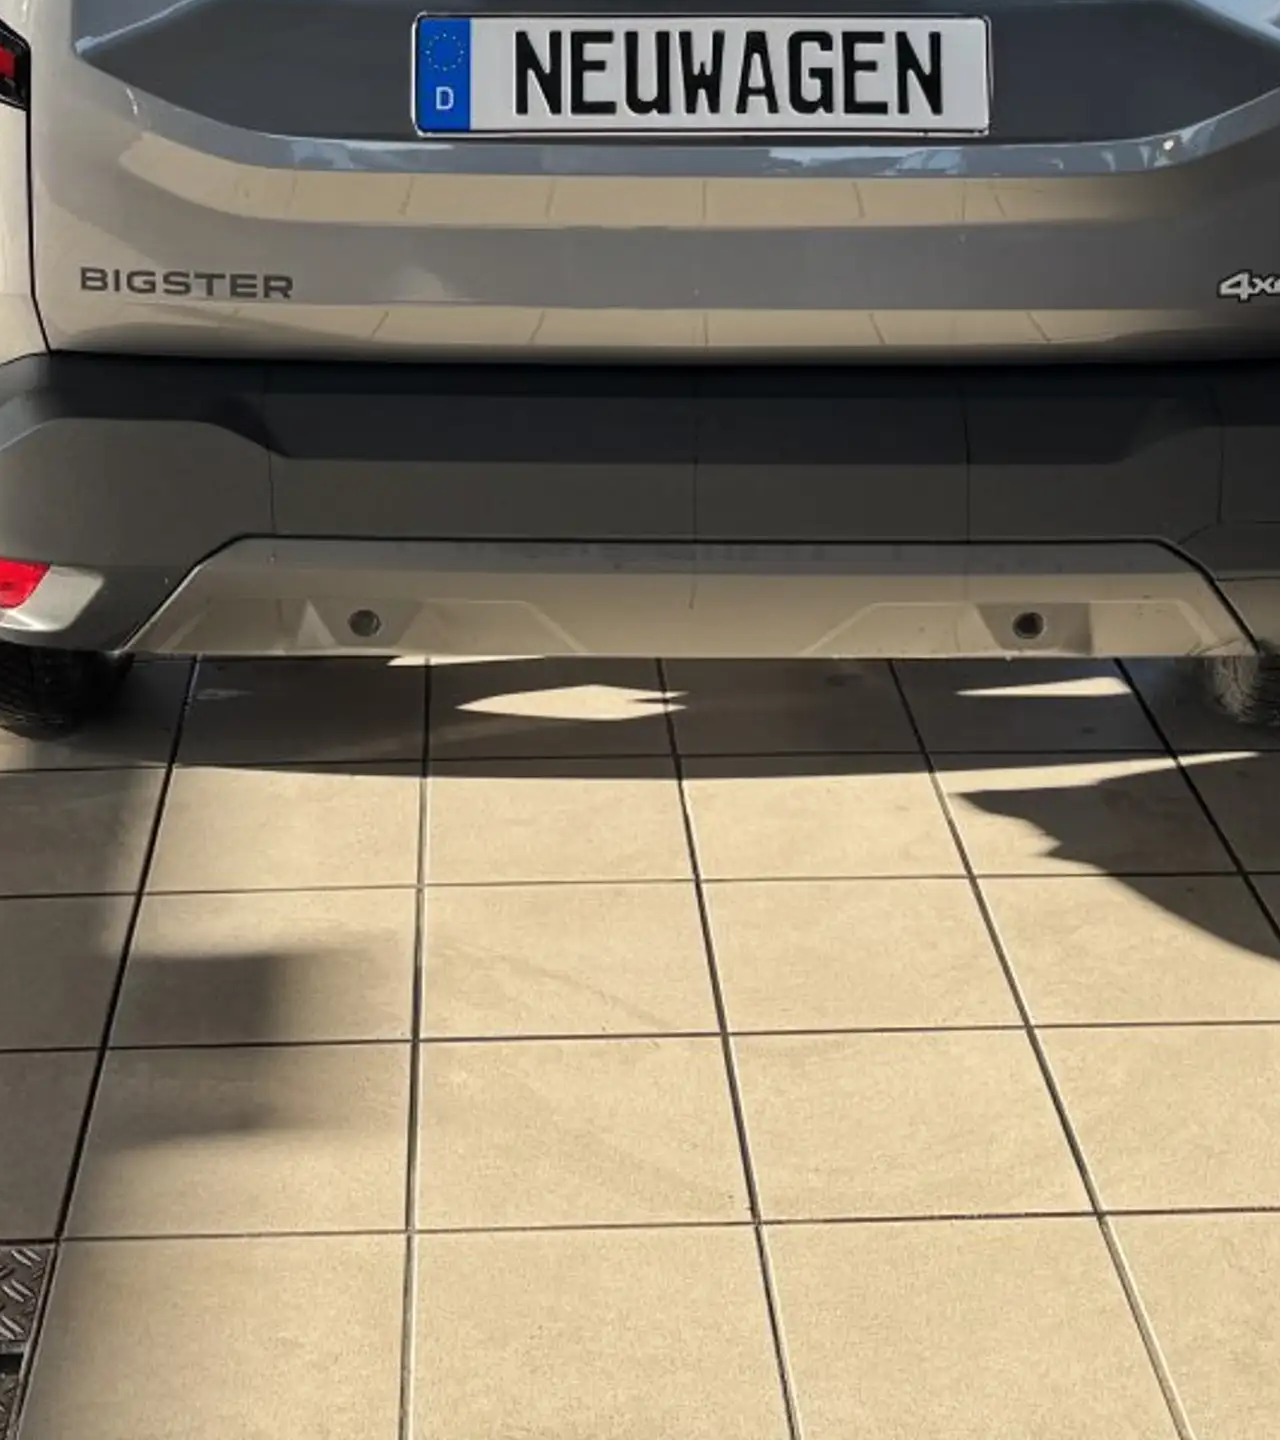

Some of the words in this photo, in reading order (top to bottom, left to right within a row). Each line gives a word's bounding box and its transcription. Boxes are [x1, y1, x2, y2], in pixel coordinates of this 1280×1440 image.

[516, 30, 943, 116] NEUWAGEN
[436, 87, 454, 111] D
[80, 267, 293, 299] BIGSTER
